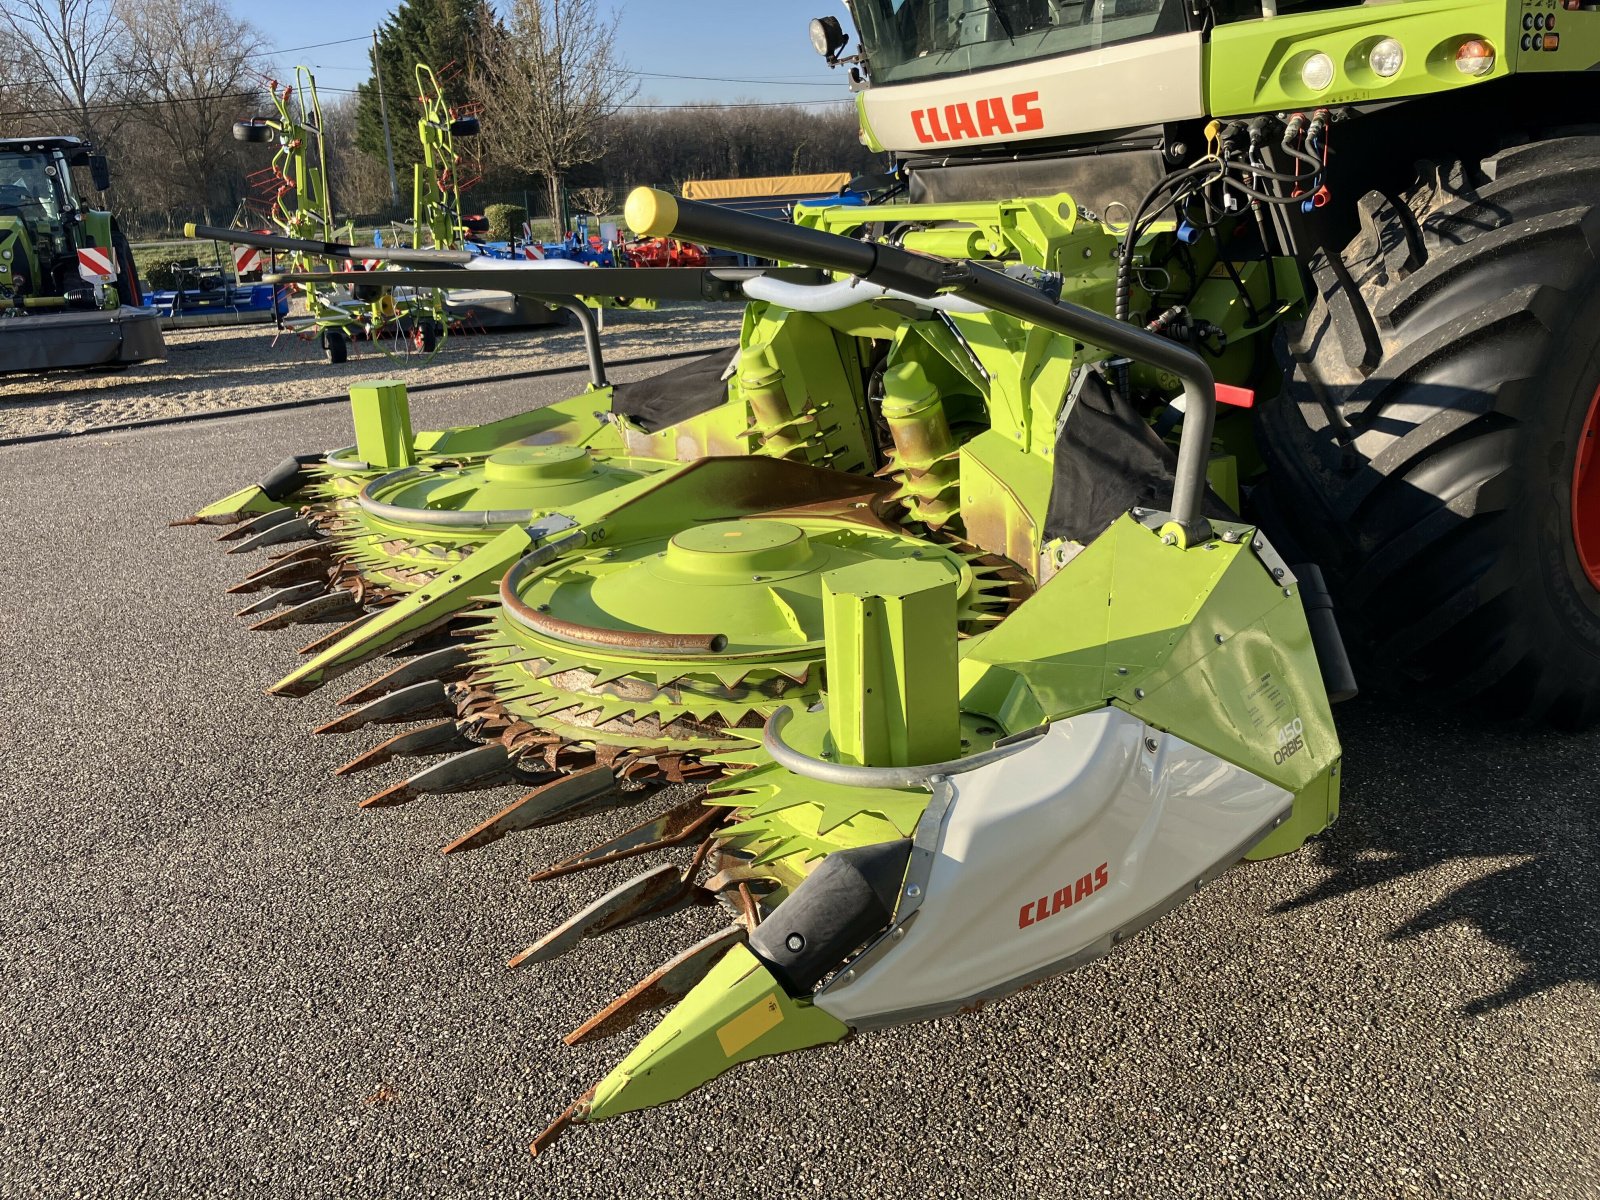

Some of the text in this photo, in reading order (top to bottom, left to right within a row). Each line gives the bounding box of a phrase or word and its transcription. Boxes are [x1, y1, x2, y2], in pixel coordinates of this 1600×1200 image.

[910, 91, 1044, 143] CLAAS
[1273, 735, 1304, 765] ORBIS
[1276, 717, 1303, 744] 450
[1018, 862, 1108, 929] CLAAS
